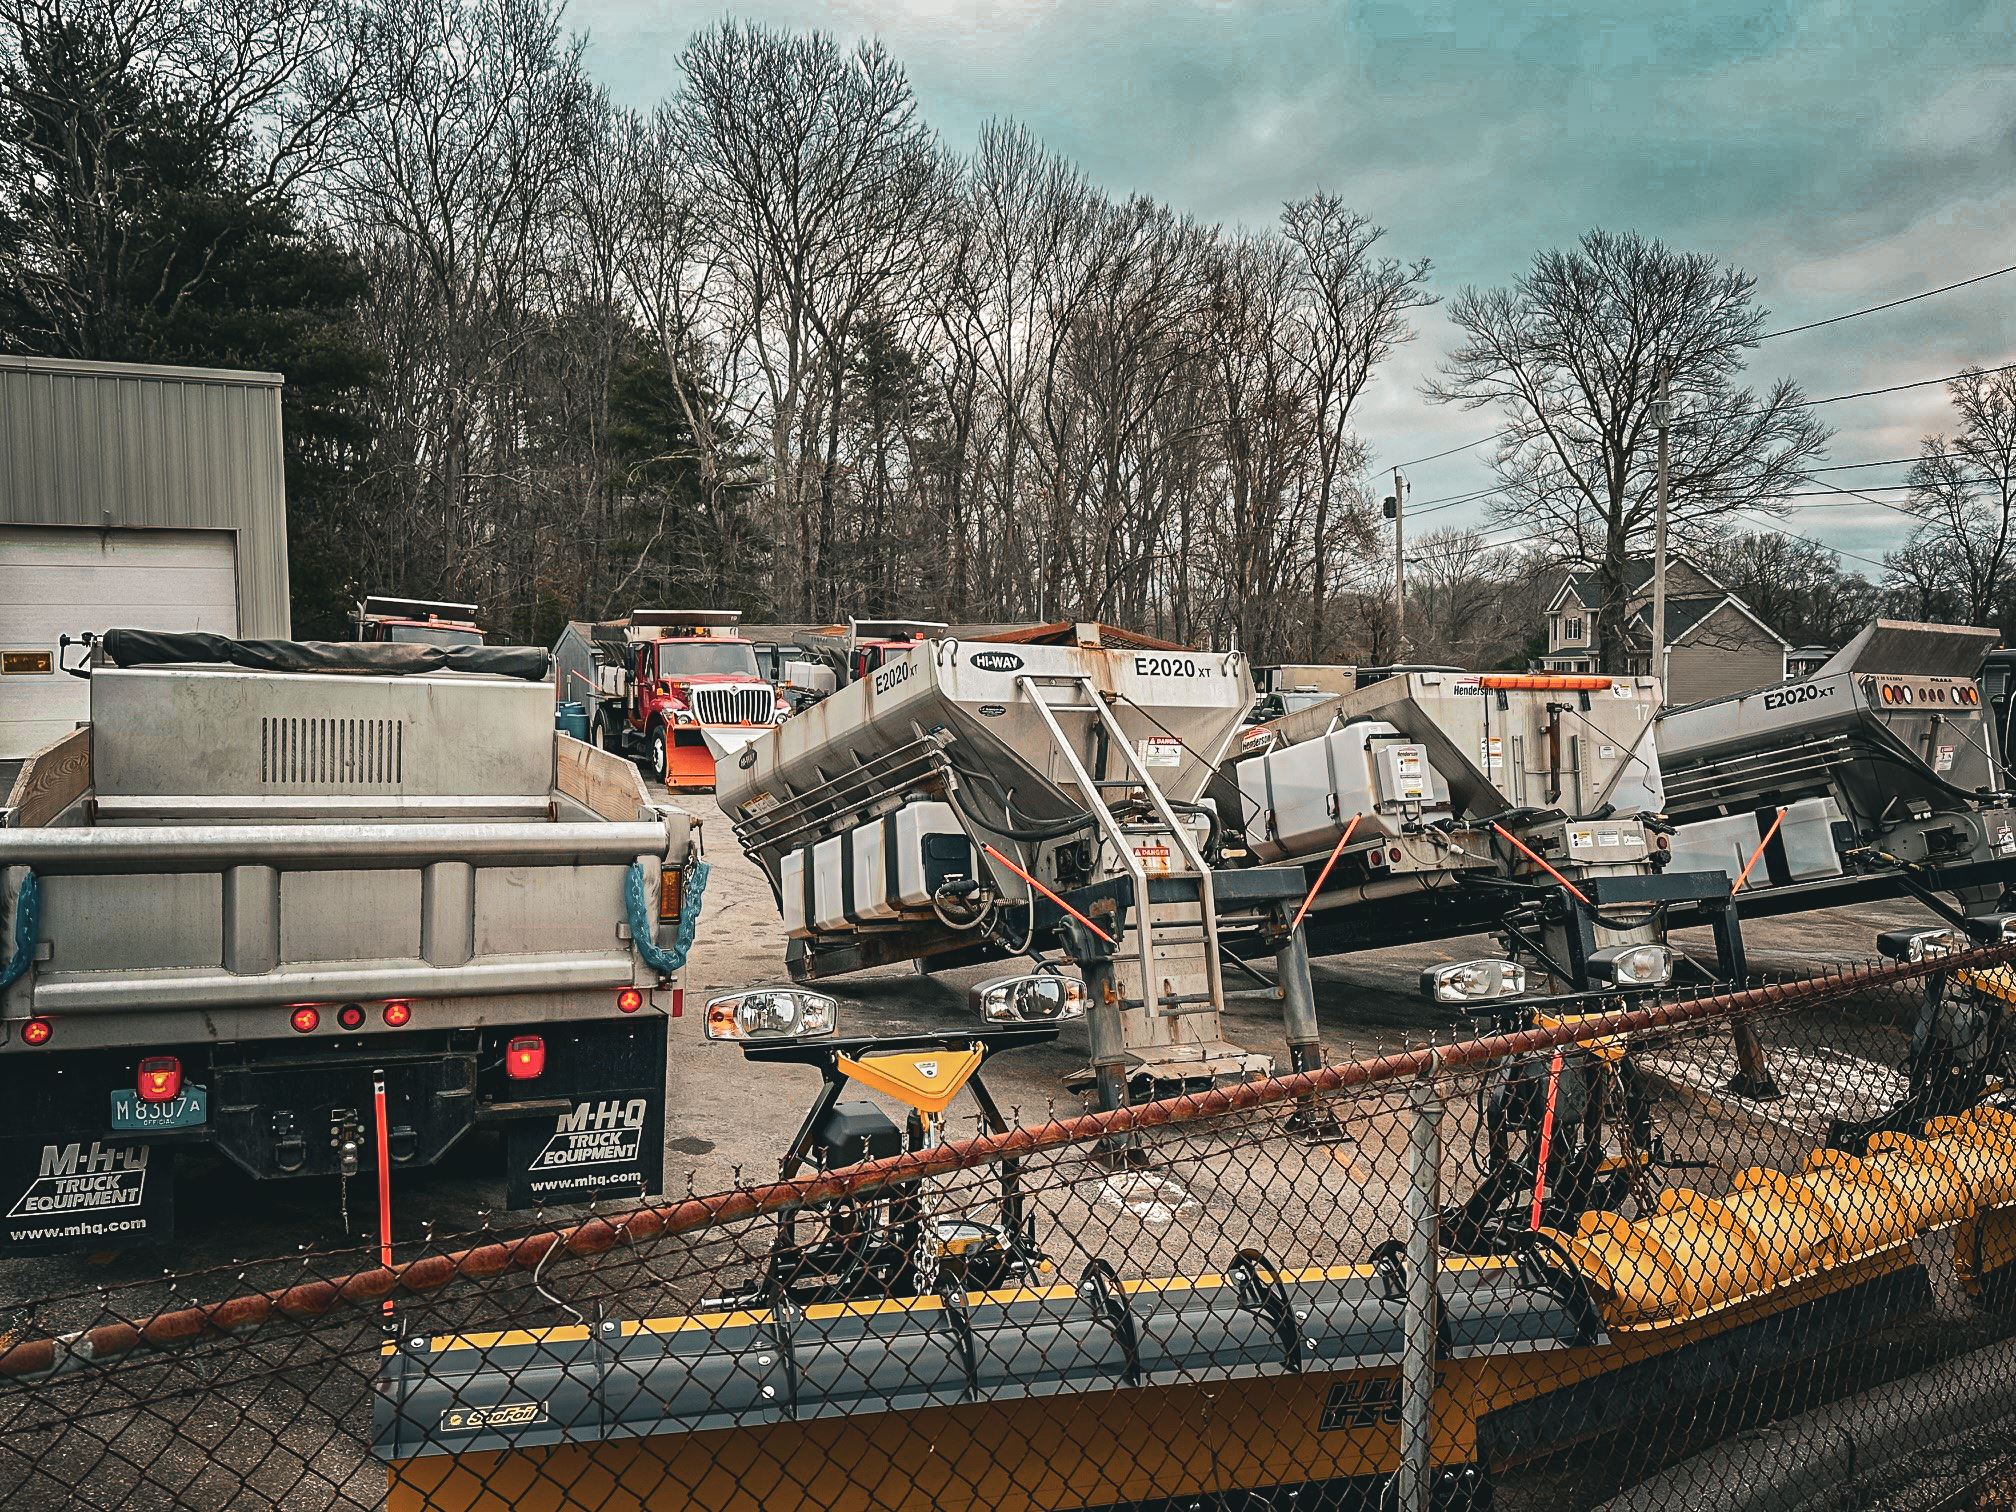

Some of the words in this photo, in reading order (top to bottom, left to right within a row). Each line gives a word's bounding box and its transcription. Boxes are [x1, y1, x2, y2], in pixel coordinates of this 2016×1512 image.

[1134, 657, 1195, 677] E2020
[875, 661, 909, 696] E2020
[1635, 704, 1650, 720] 17
[568, 1131, 623, 1149] TRUCK
[543, 1143, 636, 1165] EQUIPMENT
[55, 1174, 123, 1194] TRUCK
[530, 1171, 641, 1192] www.mhq.com
[25, 1187, 139, 1211] EQUIPMENT
[10, 1217, 147, 1240] www.mhq.com
